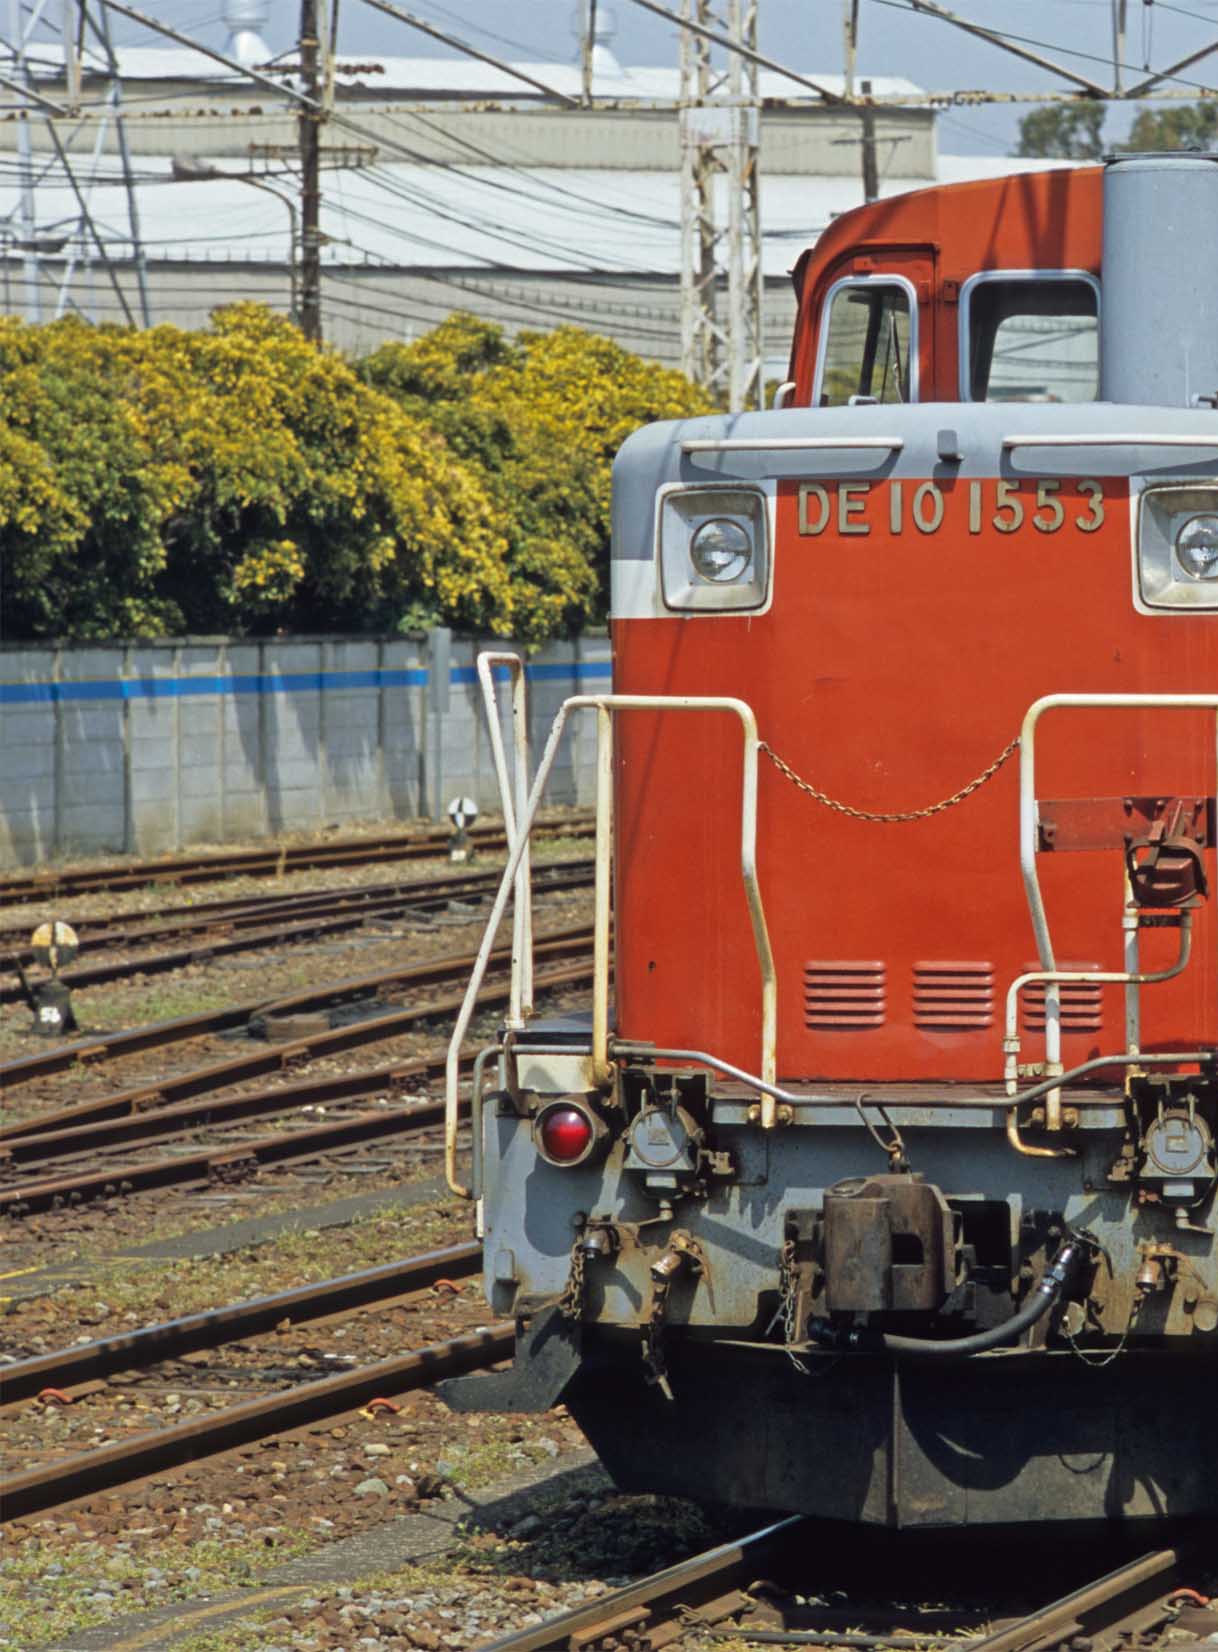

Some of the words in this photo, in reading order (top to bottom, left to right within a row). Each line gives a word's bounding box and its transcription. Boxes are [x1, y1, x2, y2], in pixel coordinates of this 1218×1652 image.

[798, 481, 871, 535] DE
[889, 480, 945, 535] 10
[968, 479, 1105, 534] 1553
